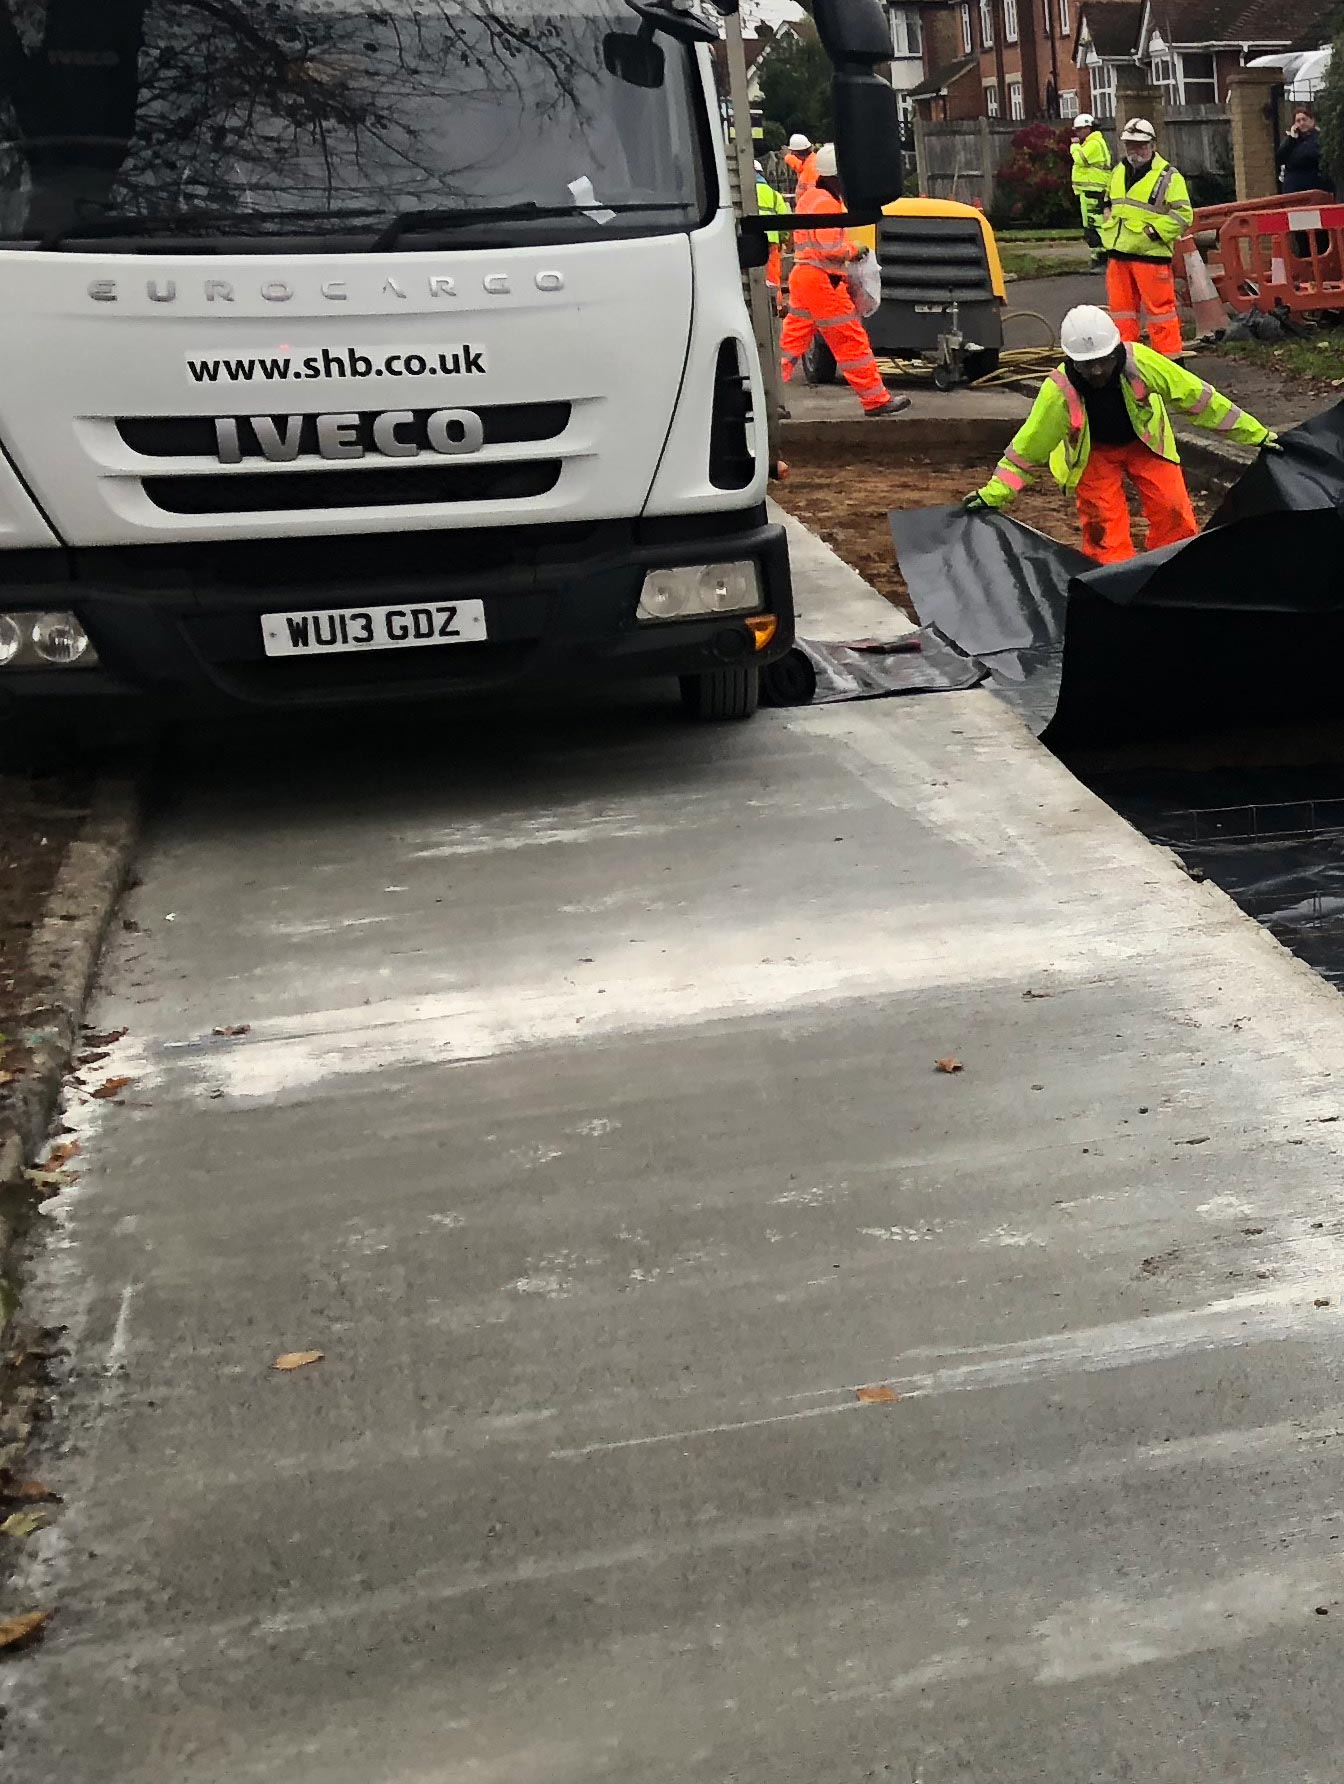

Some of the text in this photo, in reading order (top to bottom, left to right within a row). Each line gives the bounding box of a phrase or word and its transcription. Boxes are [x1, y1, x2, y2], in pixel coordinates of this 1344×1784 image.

[87, 270, 565, 302] EUROCARGO
[187, 345, 486, 382] www.shb.co.uk
[214, 409, 484, 464] IVECO
[286, 606, 461, 647] WU13 GDZ
